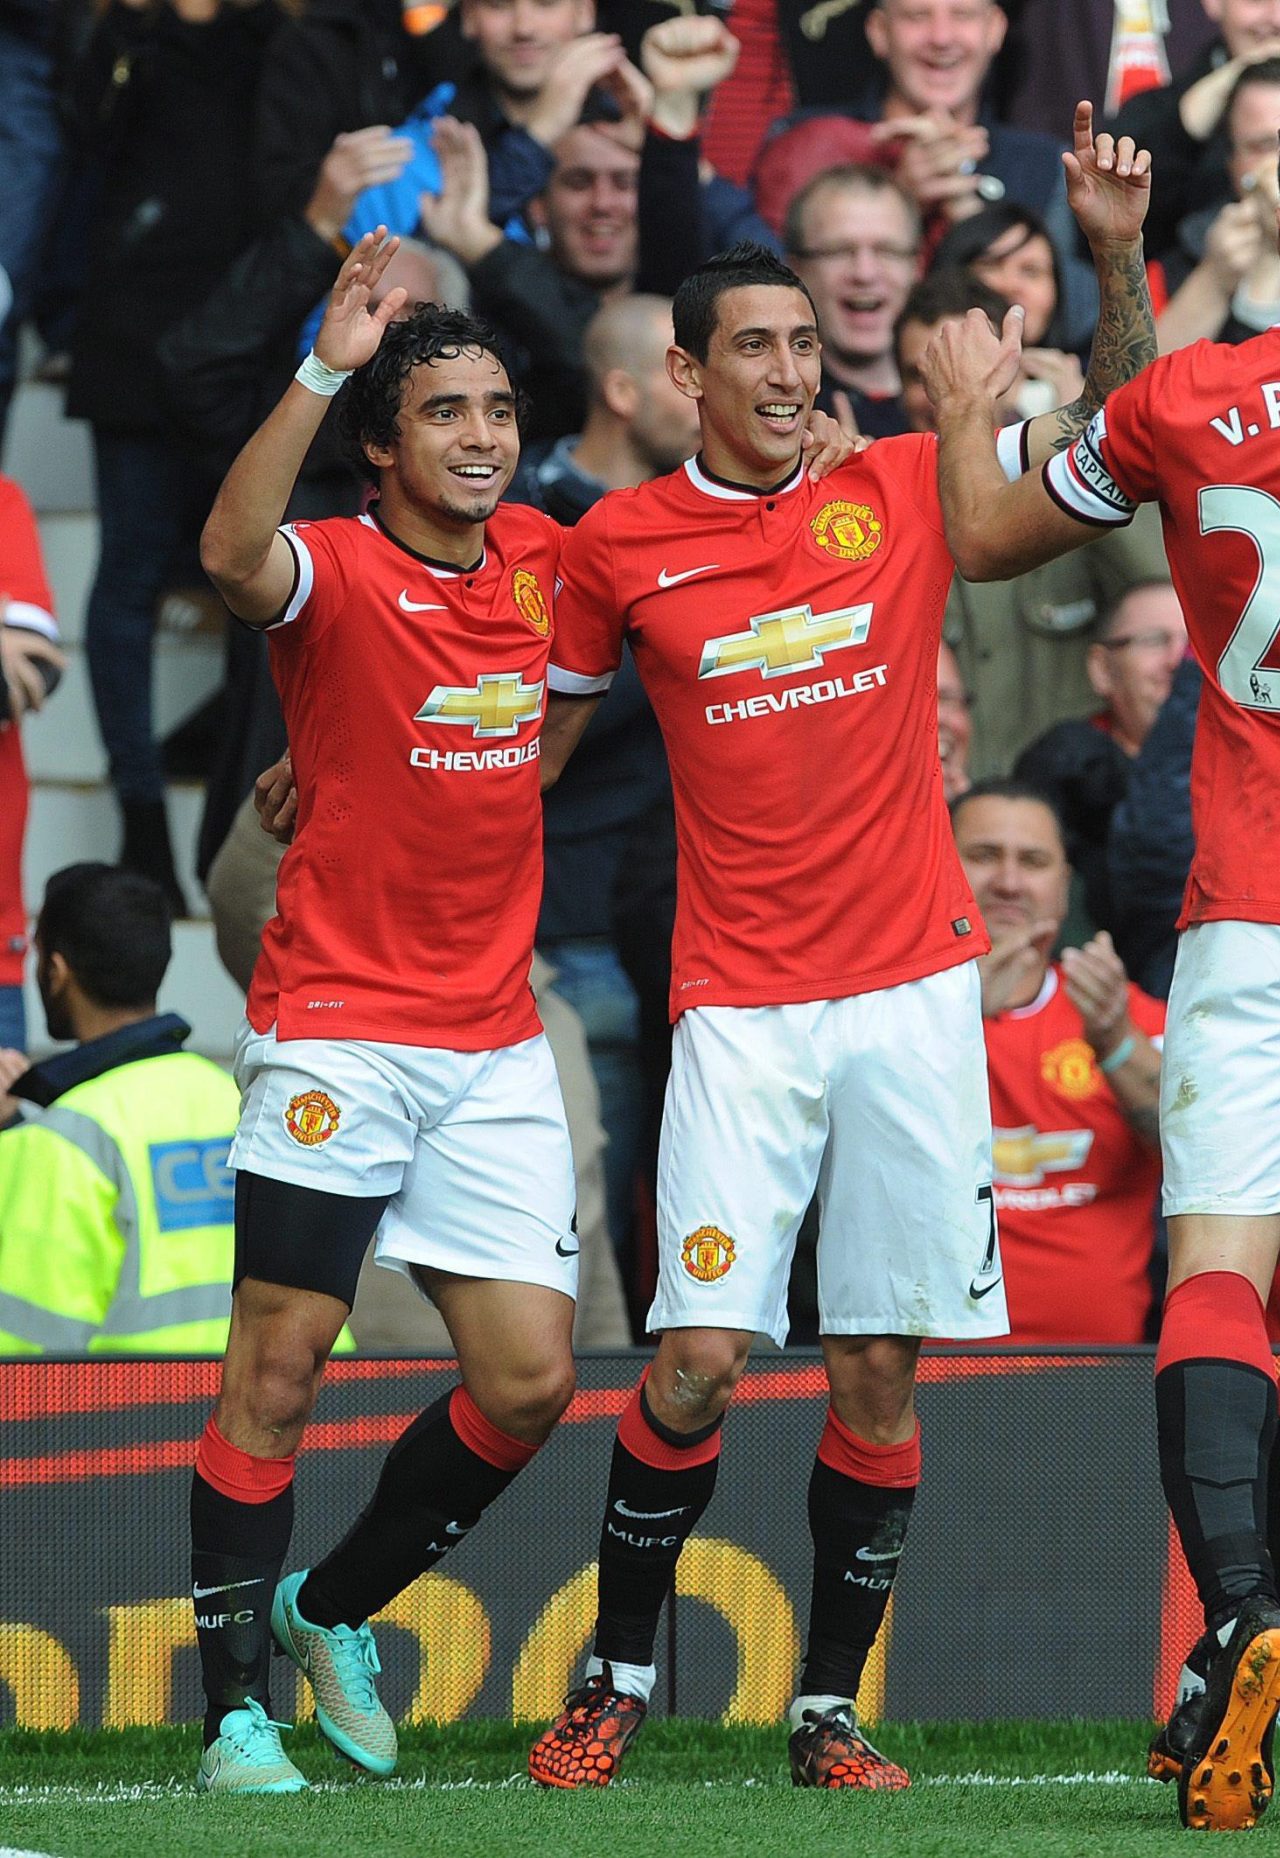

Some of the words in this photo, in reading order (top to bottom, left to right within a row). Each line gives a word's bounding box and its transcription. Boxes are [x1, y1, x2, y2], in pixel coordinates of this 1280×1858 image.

[705, 664, 888, 725] CHEVROLET
[409, 736, 540, 771] CHEVROLET
[608, 1522, 677, 1548] MUFC
[844, 1570, 895, 1590] MUF
[194, 1610, 254, 1629] MUFC
